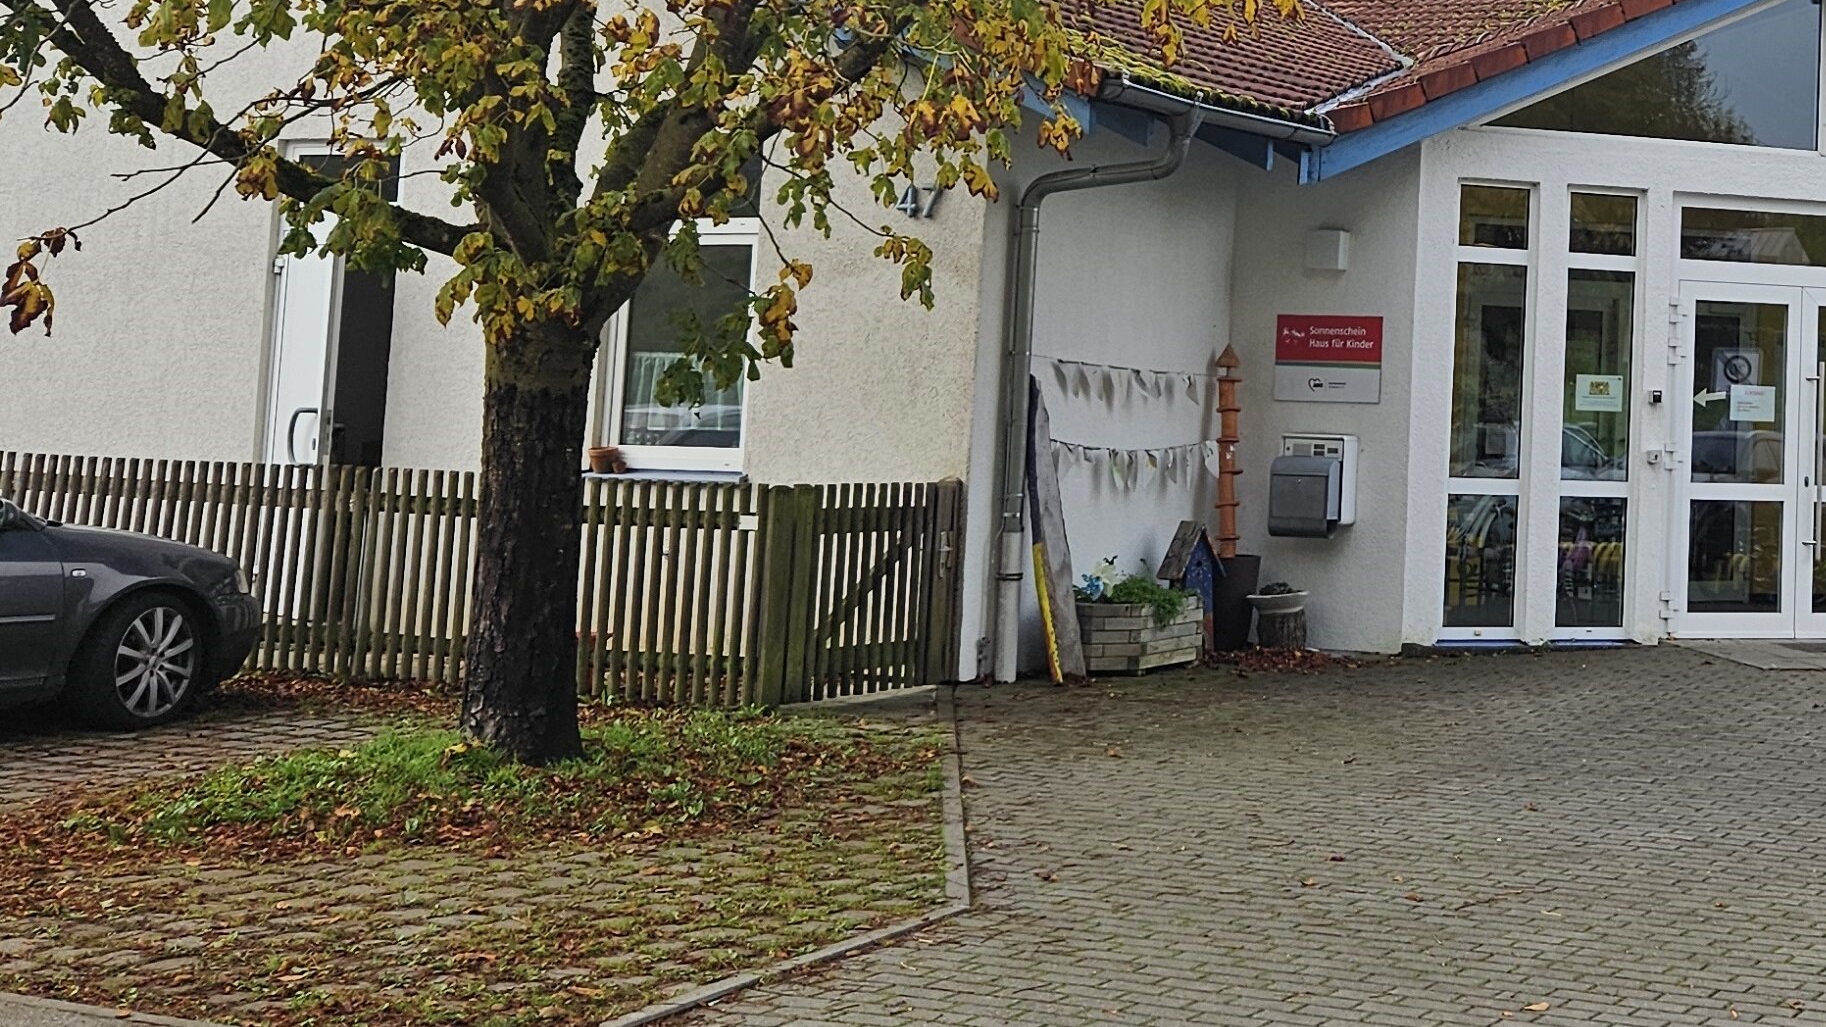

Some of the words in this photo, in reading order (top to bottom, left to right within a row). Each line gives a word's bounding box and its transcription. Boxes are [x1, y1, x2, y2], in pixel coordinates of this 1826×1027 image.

[894, 183, 943, 218] 47
[1309, 326, 1366, 336] Sonnenschein
[1309, 338, 1329, 348] Haus
[1331, 338, 1344, 348] für
[1346, 339, 1374, 349] Kinder
